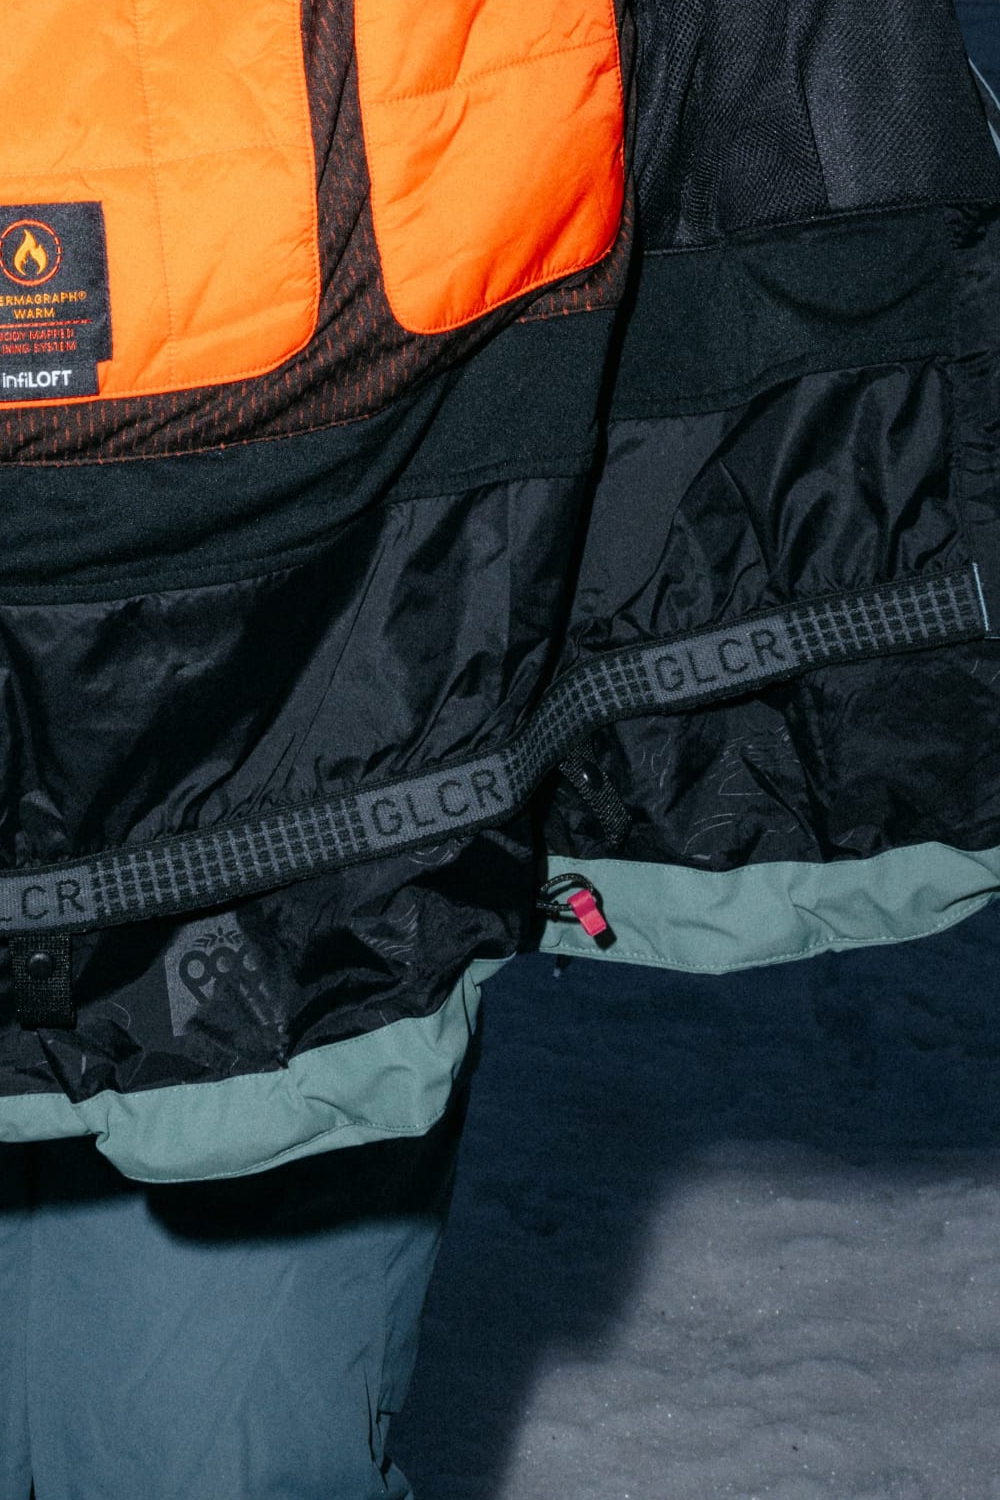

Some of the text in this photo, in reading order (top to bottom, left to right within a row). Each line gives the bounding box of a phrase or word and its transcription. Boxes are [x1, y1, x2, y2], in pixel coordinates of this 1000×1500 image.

[13, 307, 55, 319] WARM
[29, 328, 74, 340] MAPPED
[33, 340, 76, 353] SYSTEM
[2, 369, 72, 389] infiLOFT
[652, 629, 785, 693] GLCR
[371, 768, 504, 838] GLCR
